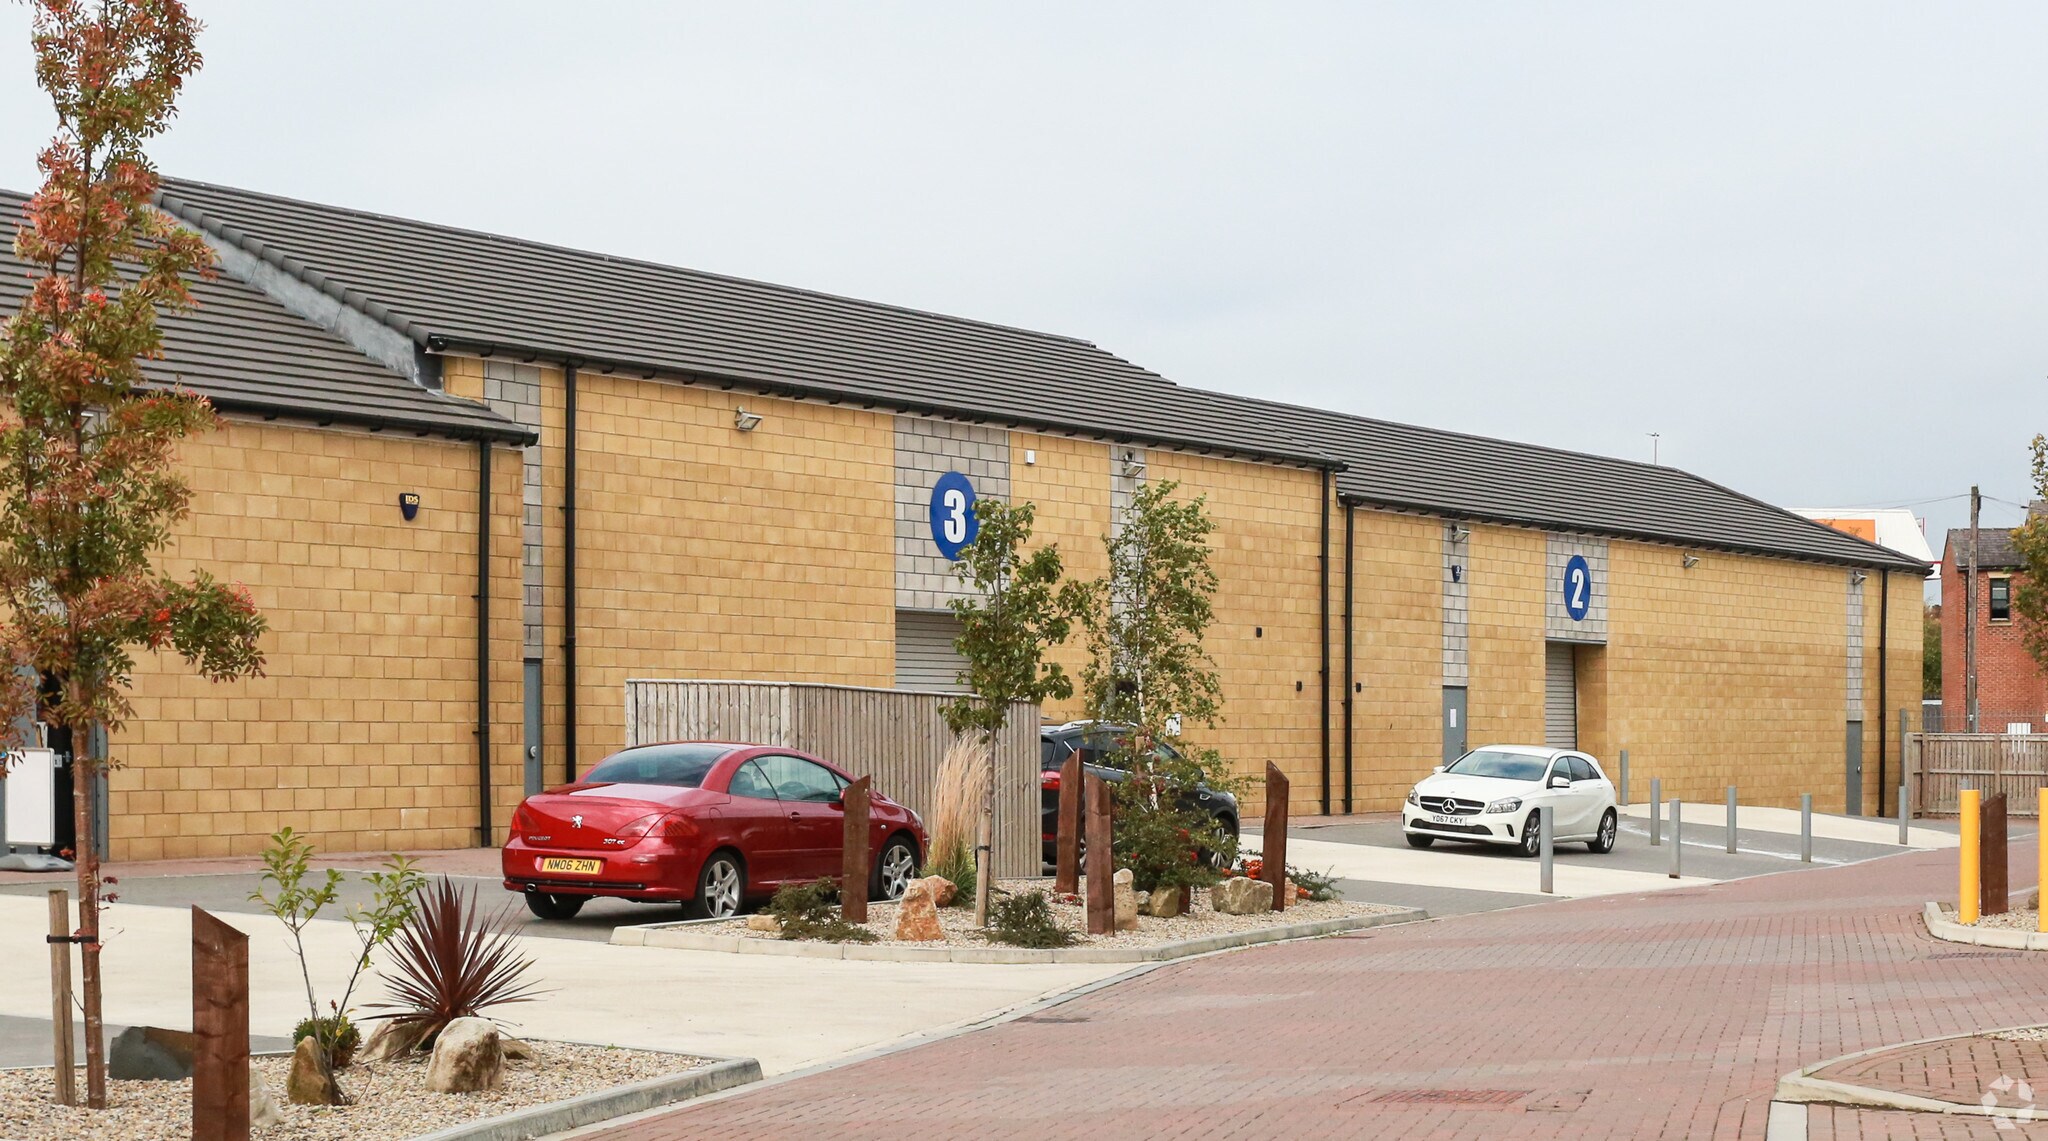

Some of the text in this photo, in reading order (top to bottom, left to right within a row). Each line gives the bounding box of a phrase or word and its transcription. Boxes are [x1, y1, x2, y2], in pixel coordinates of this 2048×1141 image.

[944, 489, 966, 544] 3
[1571, 568, 1585, 609] 2
[1450, 816, 1464, 824] CKY
[547, 859, 596, 872] NM06 ZHN
